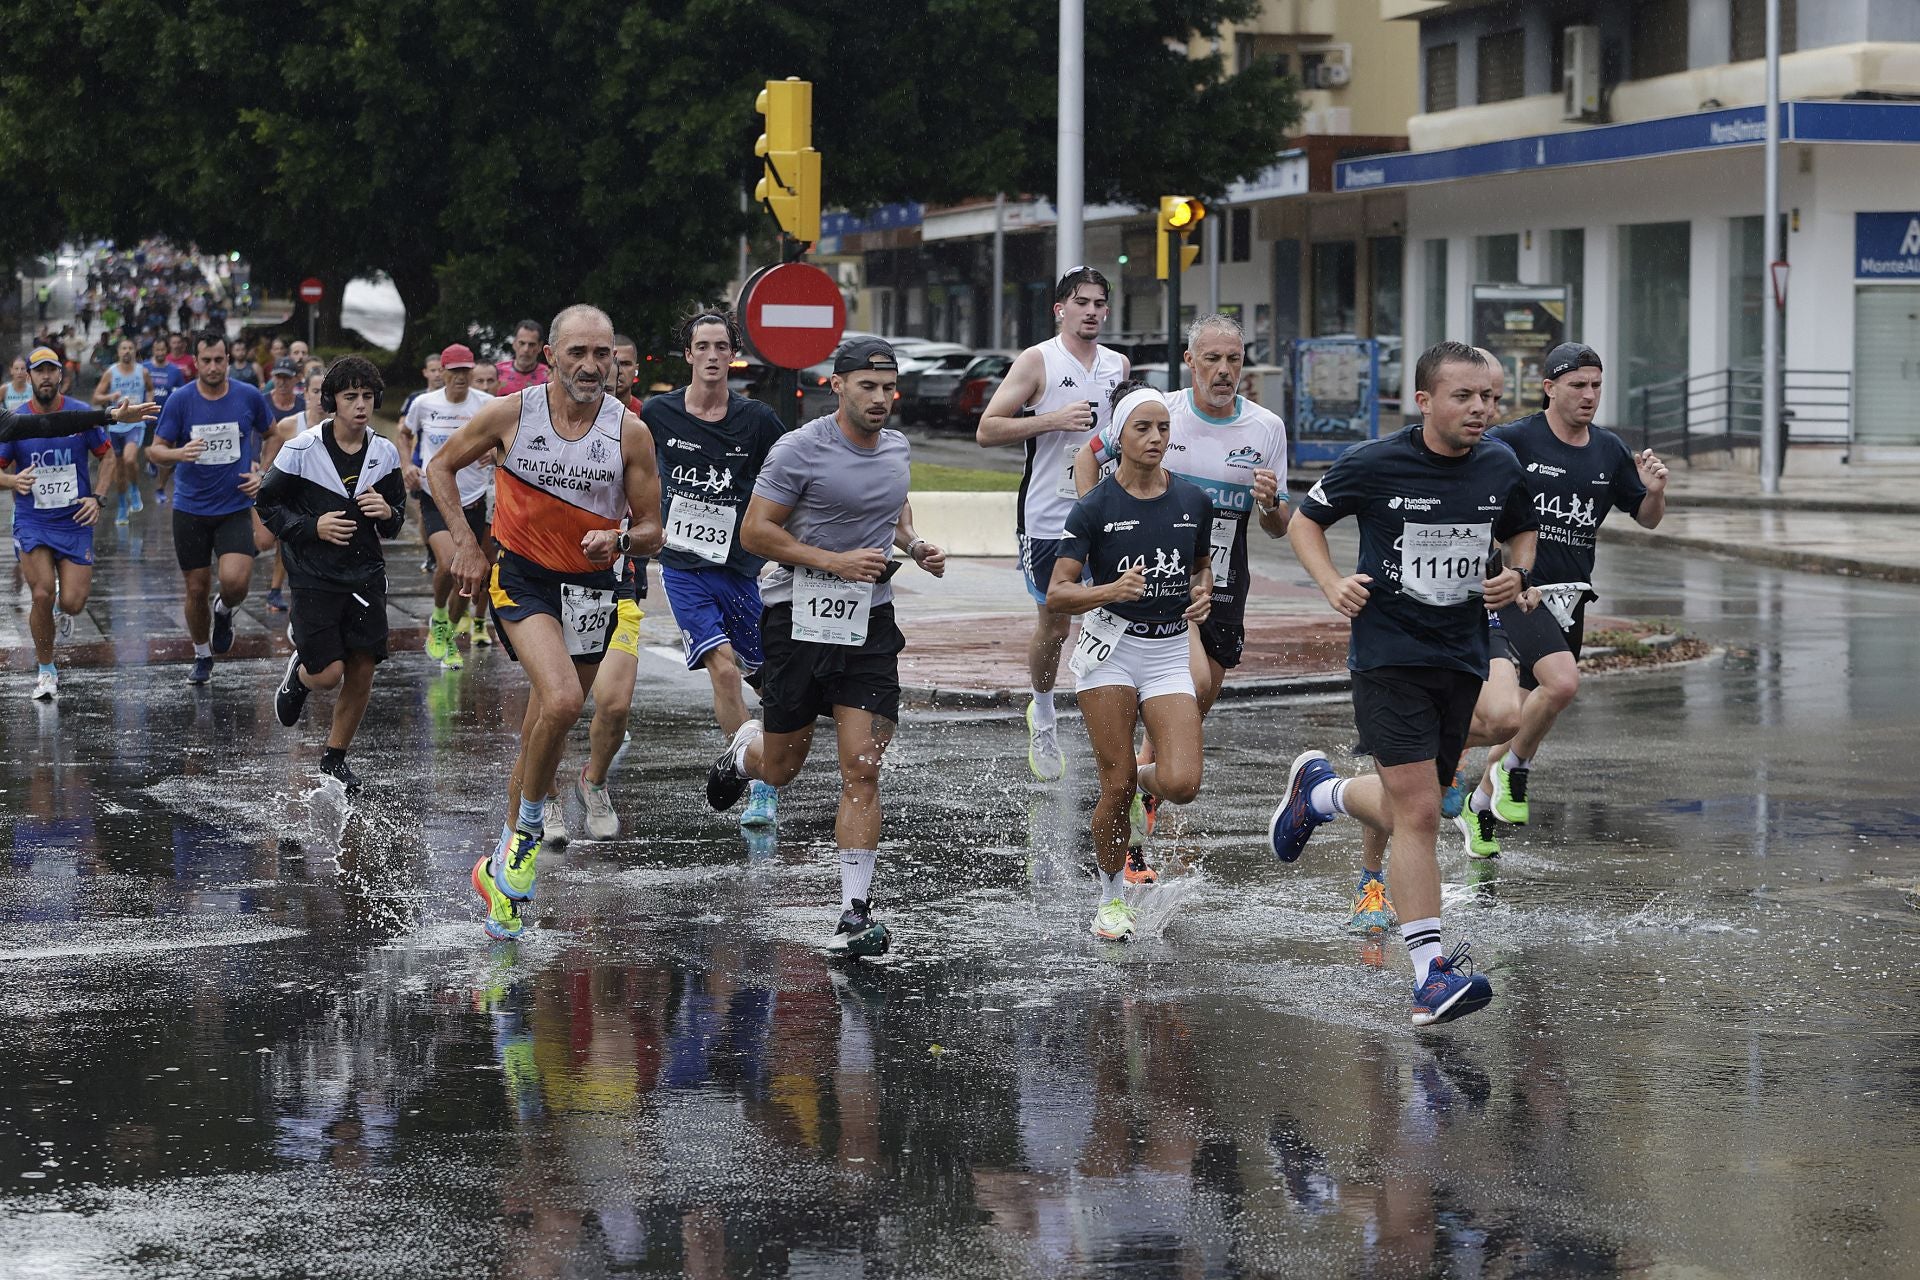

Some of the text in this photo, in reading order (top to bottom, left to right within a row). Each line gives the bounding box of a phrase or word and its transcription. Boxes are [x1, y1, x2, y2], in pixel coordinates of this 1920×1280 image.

[517, 458, 566, 476] TRIATLÓN
[39, 481, 70, 495] 3572
[537, 475, 592, 492] SENEGAR
[1404, 497, 1441, 505] Fundación
[1404, 503, 1431, 512] Unicaja
[674, 520, 728, 545] 11233
[1210, 544, 1228, 564] 77
[1411, 556, 1480, 579] 11101
[807, 597, 859, 620] 1297
[1154, 619, 1188, 636] NIKE
